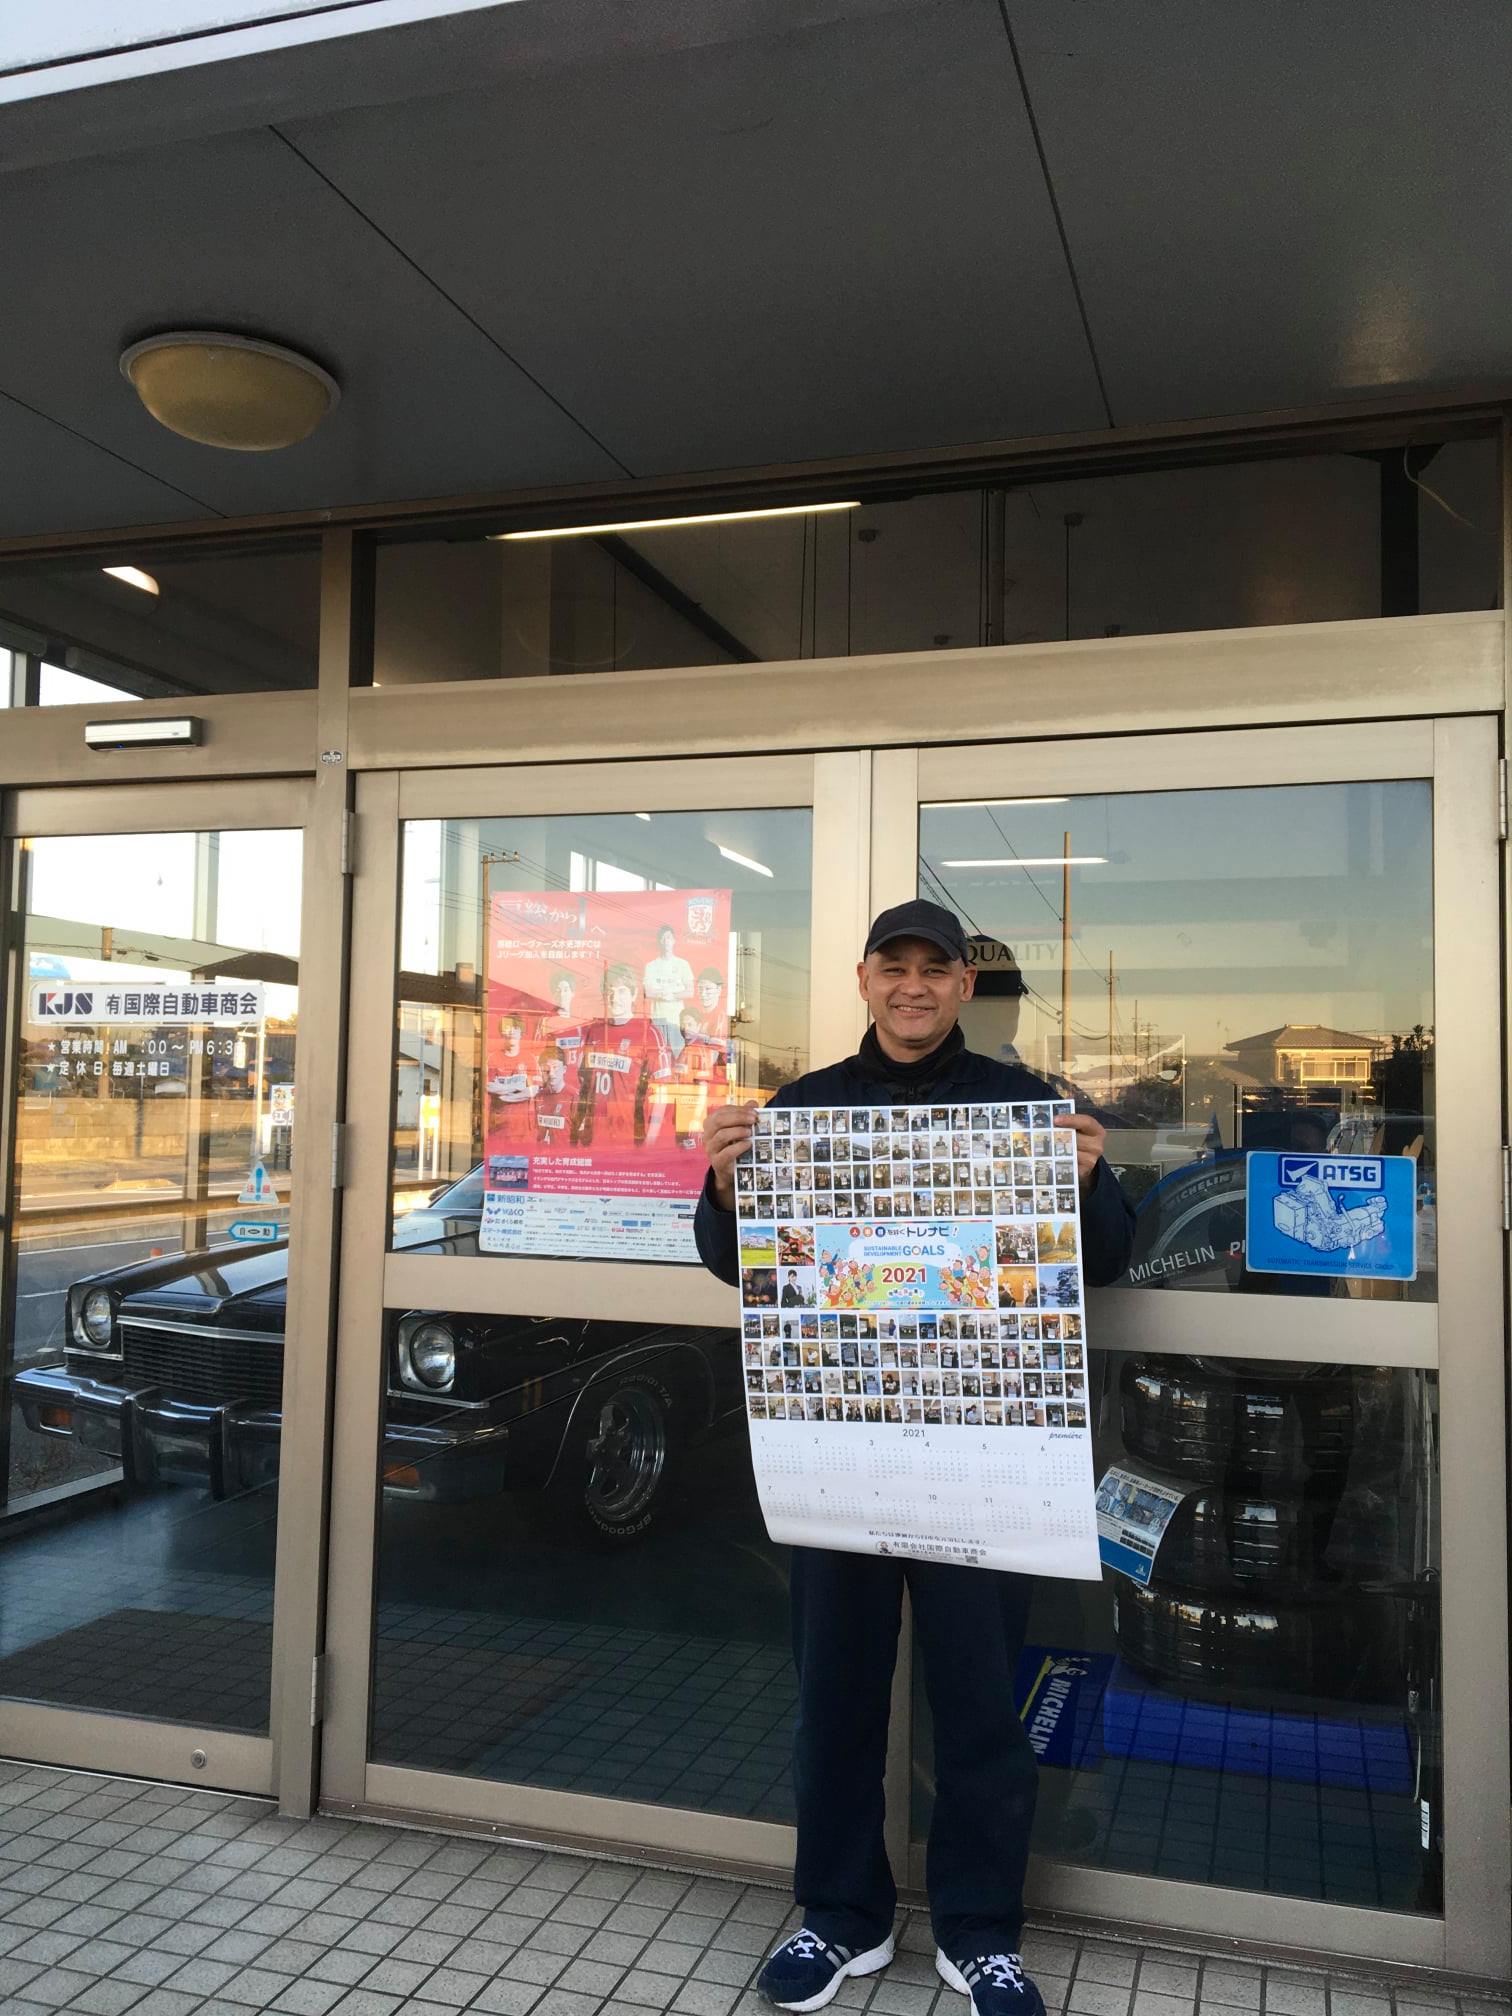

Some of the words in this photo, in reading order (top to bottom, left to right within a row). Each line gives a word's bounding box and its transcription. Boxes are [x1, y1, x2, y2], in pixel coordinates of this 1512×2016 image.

[38, 992, 94, 1016] KJS
[594, 1072, 612, 1096] 10
[1322, 1163, 1378, 1183] ATSG
[902, 1244, 945, 1256] GOALS
[1128, 1243, 1216, 1284] MICHELIN
[1230, 1240, 1246, 1257] P
[881, 1267, 927, 1283] 2021
[902, 1428, 926, 1438] 2021
[1028, 1677, 1072, 1755] MICHELIN
